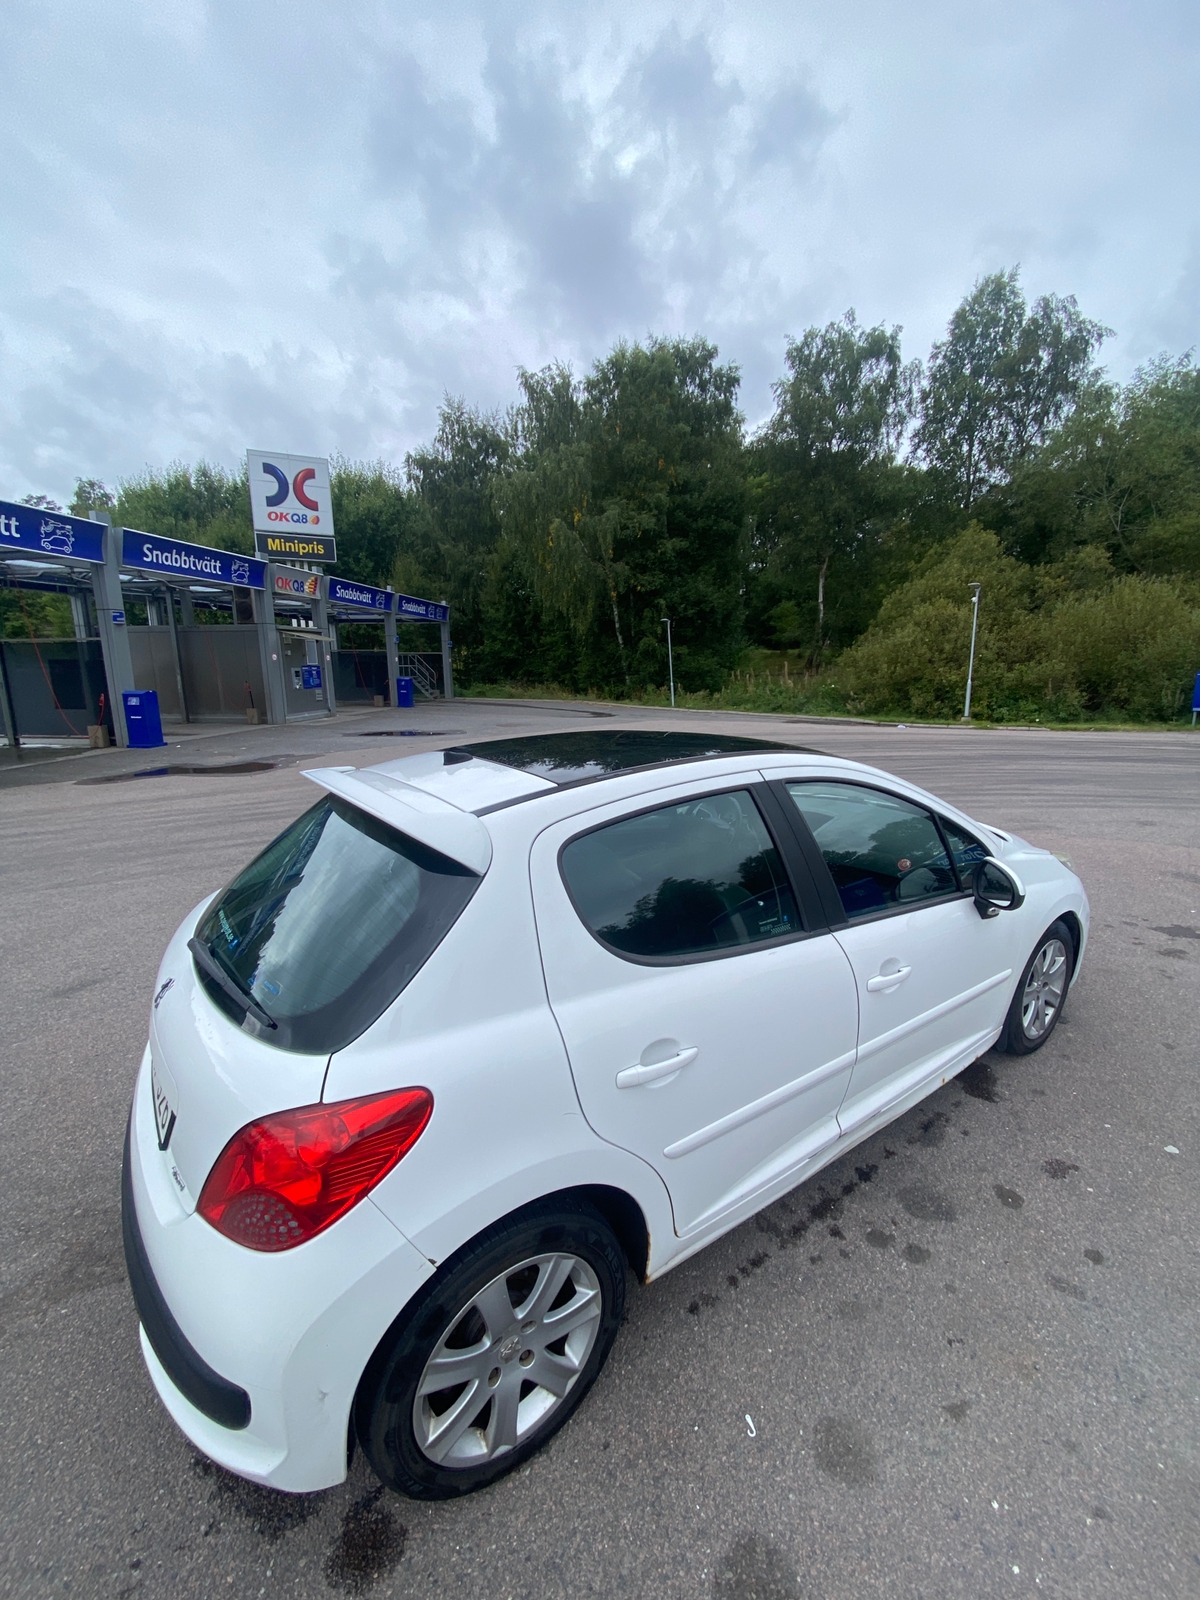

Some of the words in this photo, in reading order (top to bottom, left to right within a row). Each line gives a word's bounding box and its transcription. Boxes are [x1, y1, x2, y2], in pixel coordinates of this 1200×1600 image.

[267, 511, 308, 524] OKQ8
[267, 538, 325, 556] Minipris
[143, 543, 222, 575] Snabbtvätt
[275, 576, 305, 594] OKQ8
[336, 585, 372, 604] Snabbtvätt
